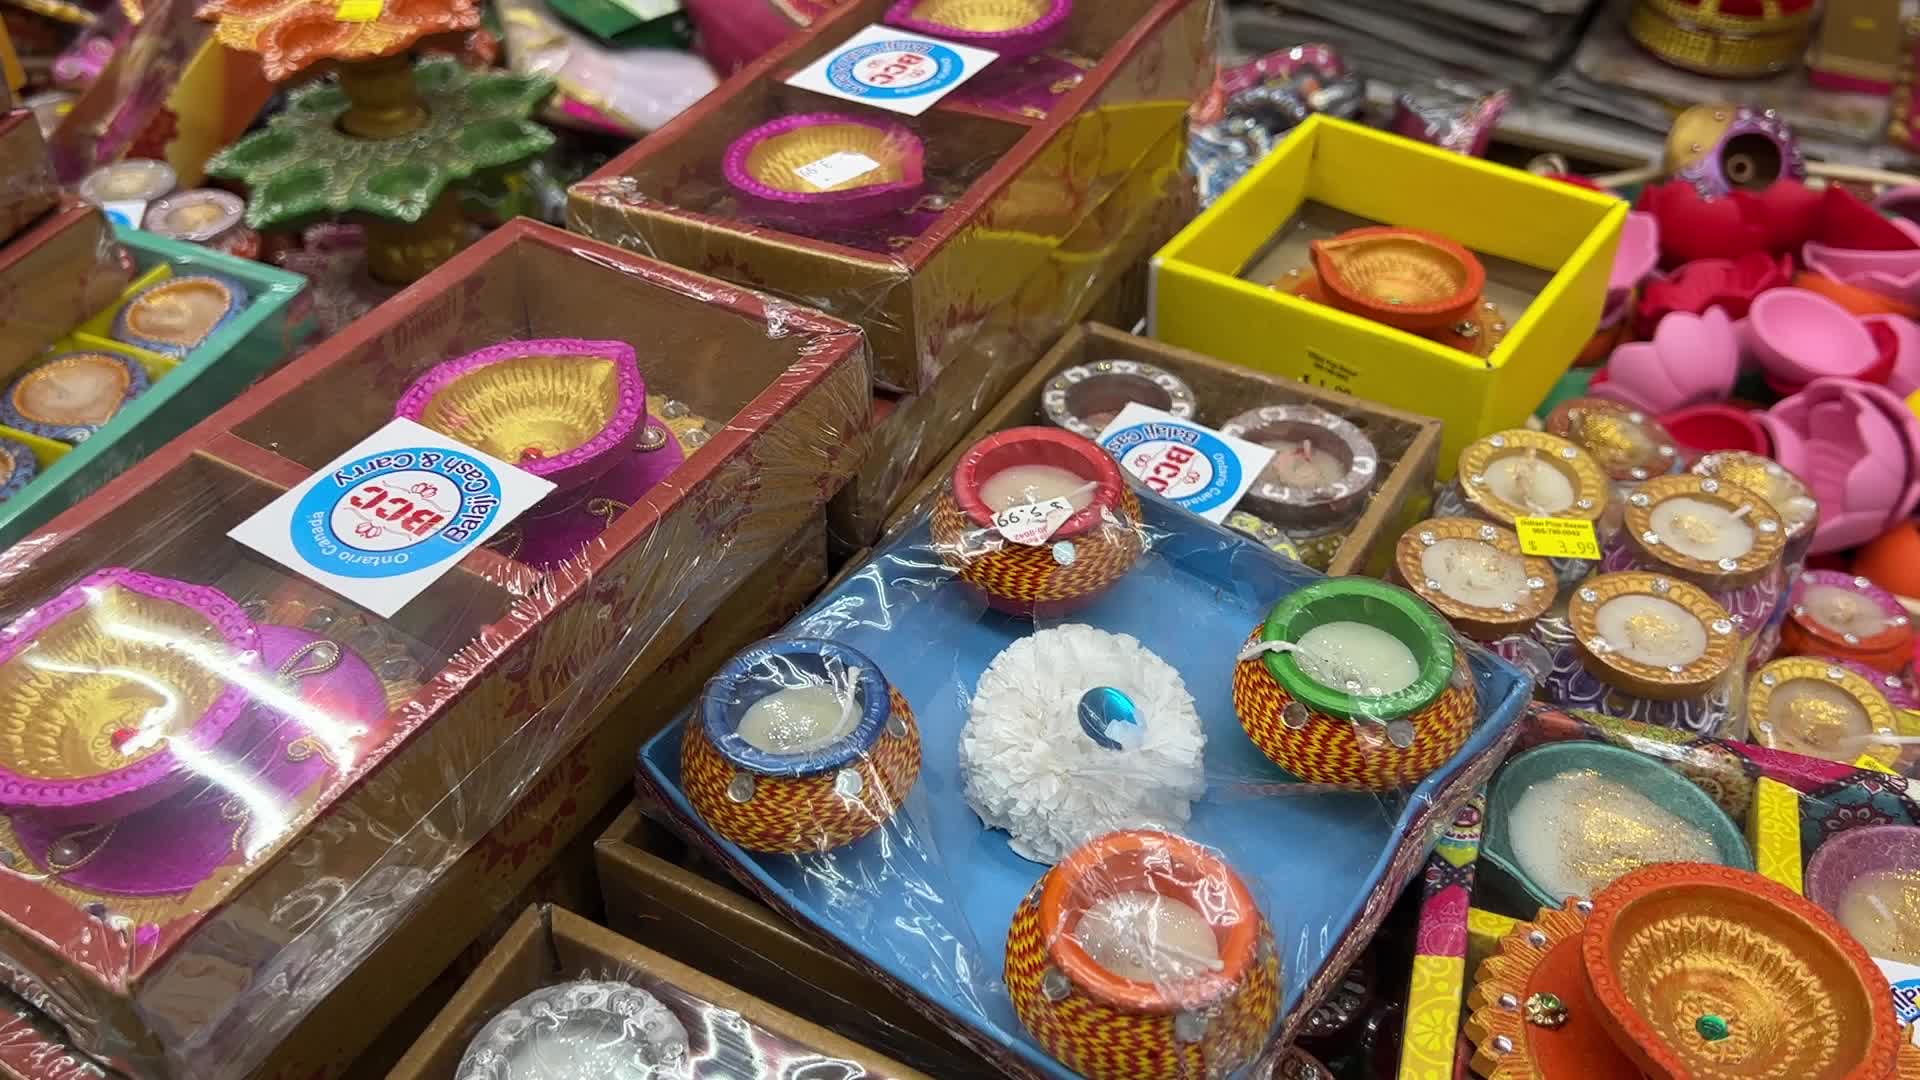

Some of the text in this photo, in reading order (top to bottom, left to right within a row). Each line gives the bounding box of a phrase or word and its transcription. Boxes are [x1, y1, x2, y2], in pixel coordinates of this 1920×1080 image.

[869, 53, 924, 84] BCC
[1107, 424, 1200, 456] Balaji Cas
[334, 452, 500, 545] Balaji Cash & Carry
[1177, 452, 1229, 508] Ontario Canad
[349, 485, 446, 536] BCC
[996, 506, 1042, 527] 5.99
[311, 511, 410, 565] Ontario Canada
[1528, 540, 1596, 555] $ 3.99
